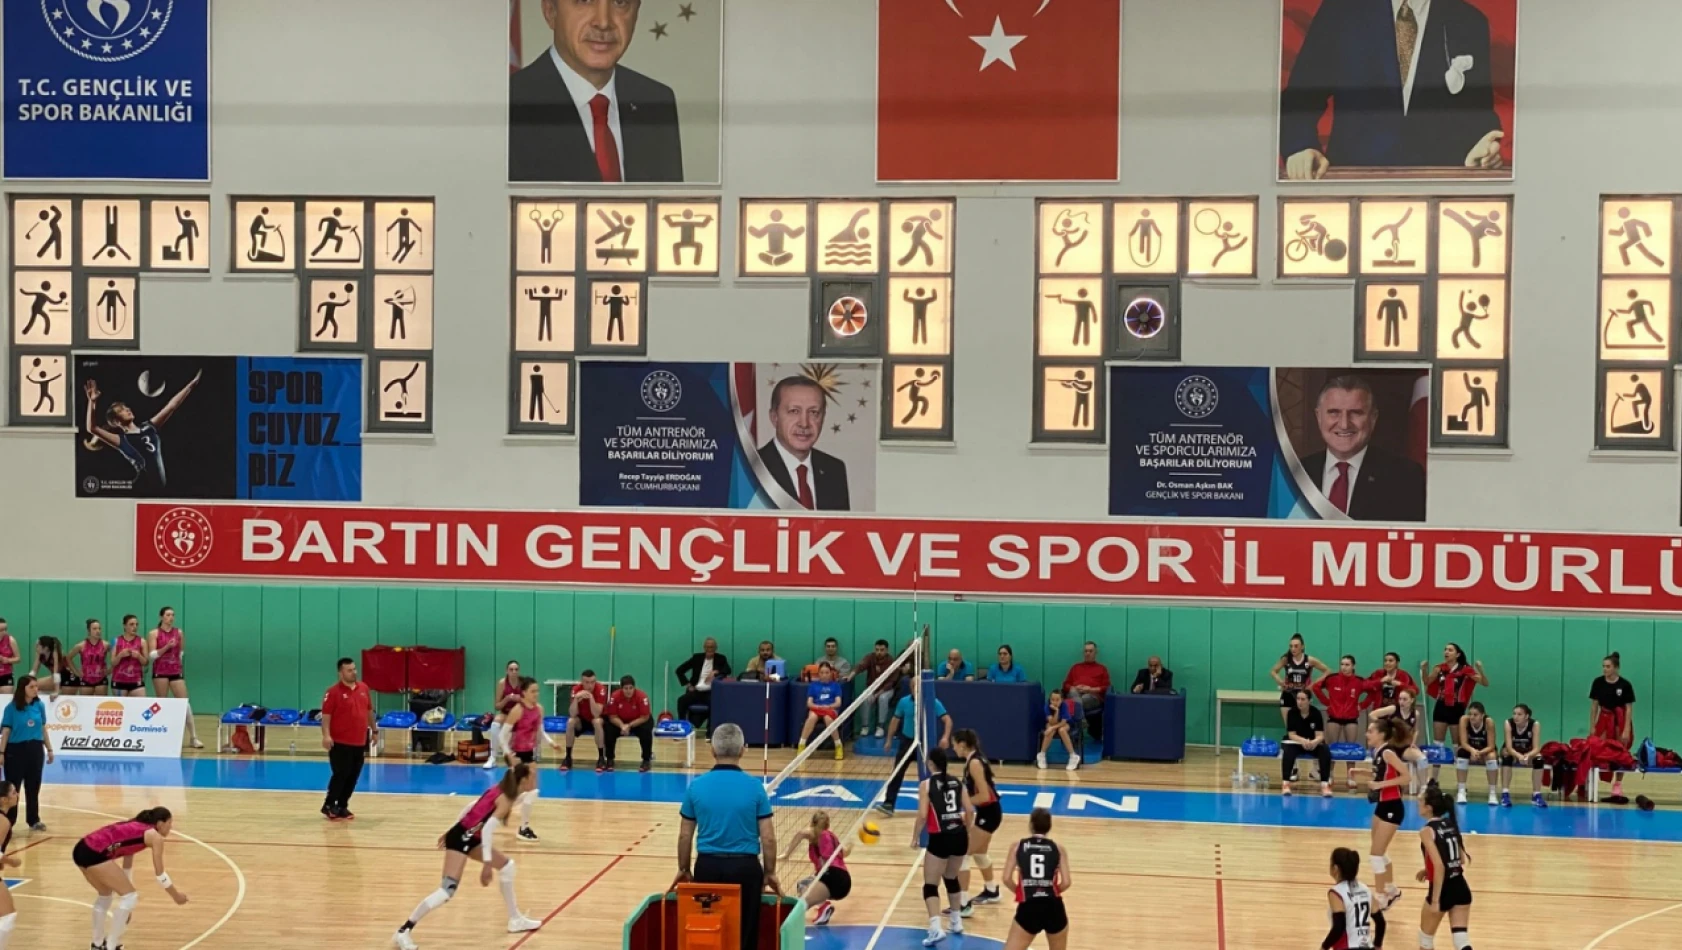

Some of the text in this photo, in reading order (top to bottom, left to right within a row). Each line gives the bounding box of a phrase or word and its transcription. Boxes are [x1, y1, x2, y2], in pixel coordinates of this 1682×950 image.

[18, 76, 193, 100] T.C. GENÇLİK VE
[18, 101, 192, 122] SPOR BAKANLIĞI
[249, 371, 323, 404] SPOR
[249, 412, 341, 446] CUYUZ
[616, 425, 706, 437] TÜM ANTRENÖR
[604, 437, 718, 450] VE SPORCULARIMIZA
[1149, 432, 1244, 444] TÜM ANTRENÖR
[144, 437, 156, 453] 3
[1136, 445, 1257, 457] VE SPORCULARIMIZA
[608, 451, 714, 461] BAŞARILAR DİLİYORUM
[249, 451, 296, 487] BİZ
[1139, 458, 1252, 469] BAŞARILAR DİLİYORUM
[619, 472, 702, 482] Recep Tayyip ERDOĞAN
[621, 483, 700, 492] T.C. CUMHURBAŞKANI
[1156, 481, 1233, 491] Dr. Osman Aşkın BAK
[1145, 491, 1244, 501] GENÇLİK VE SPOR BAKANI
[241, 517, 499, 567] BARTIN
[524, 517, 846, 581] GENÇLİK
[867, 531, 961, 578] VE
[986, 533, 1198, 584] SPOR
[1222, 528, 1286, 586] İL
[95, 717, 122, 726] KING
[129, 724, 168, 733] Domino's
[61, 735, 90, 748] kuzi
[943, 789, 957, 813] 9
[1445, 836, 1459, 860] 11
[1030, 854, 1045, 879] 6
[1354, 901, 1371, 928] 12
